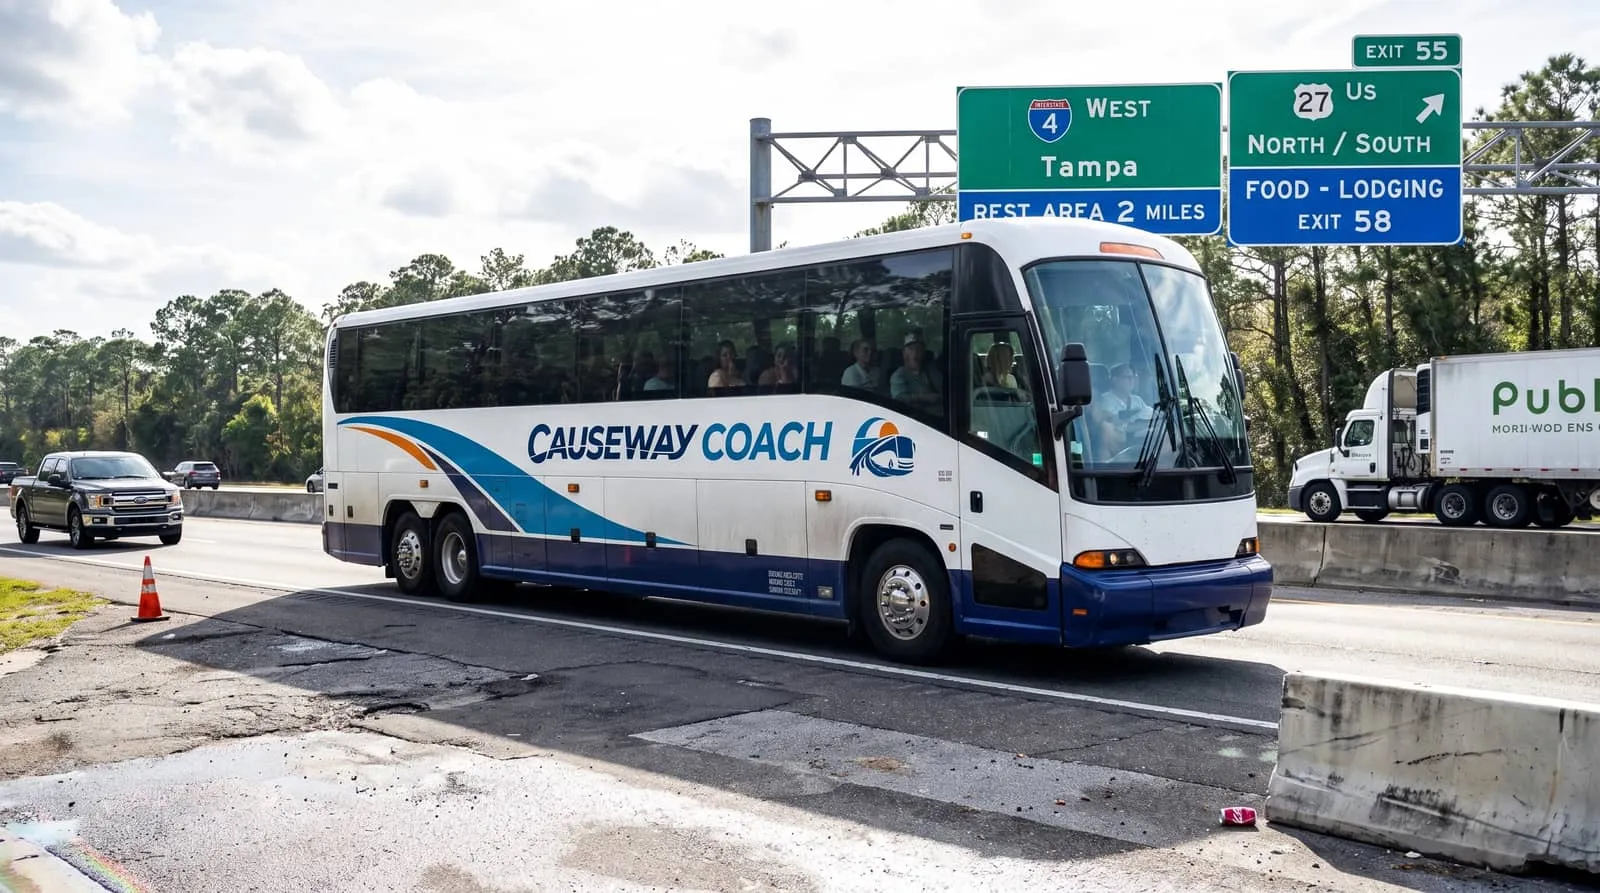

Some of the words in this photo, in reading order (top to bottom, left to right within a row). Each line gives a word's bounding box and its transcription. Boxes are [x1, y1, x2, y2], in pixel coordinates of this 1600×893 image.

[1366, 45, 1404, 59] EXIT
[1416, 41, 1447, 60] 55
[1086, 97, 1151, 118] WEST
[1298, 92, 1329, 112] 27
[1042, 112, 1058, 134] 4
[1248, 134, 1324, 154] NORTH
[1332, 131, 1347, 156] /
[1355, 133, 1431, 153] SOUTH
[1041, 156, 1137, 182] Tampa
[1246, 180, 1309, 200] FOOD
[1340, 179, 1444, 199] LODGING
[973, 203, 1030, 219] REST
[1043, 203, 1104, 221] AREA
[1117, 200, 1135, 223] 2
[1146, 204, 1205, 220] MILES
[1298, 214, 1342, 230] EXIT
[1355, 210, 1392, 233] 58
[1567, 422, 1593, 433] ENS
[528, 424, 699, 464] CAUSEWAY
[702, 421, 833, 461] COACH
